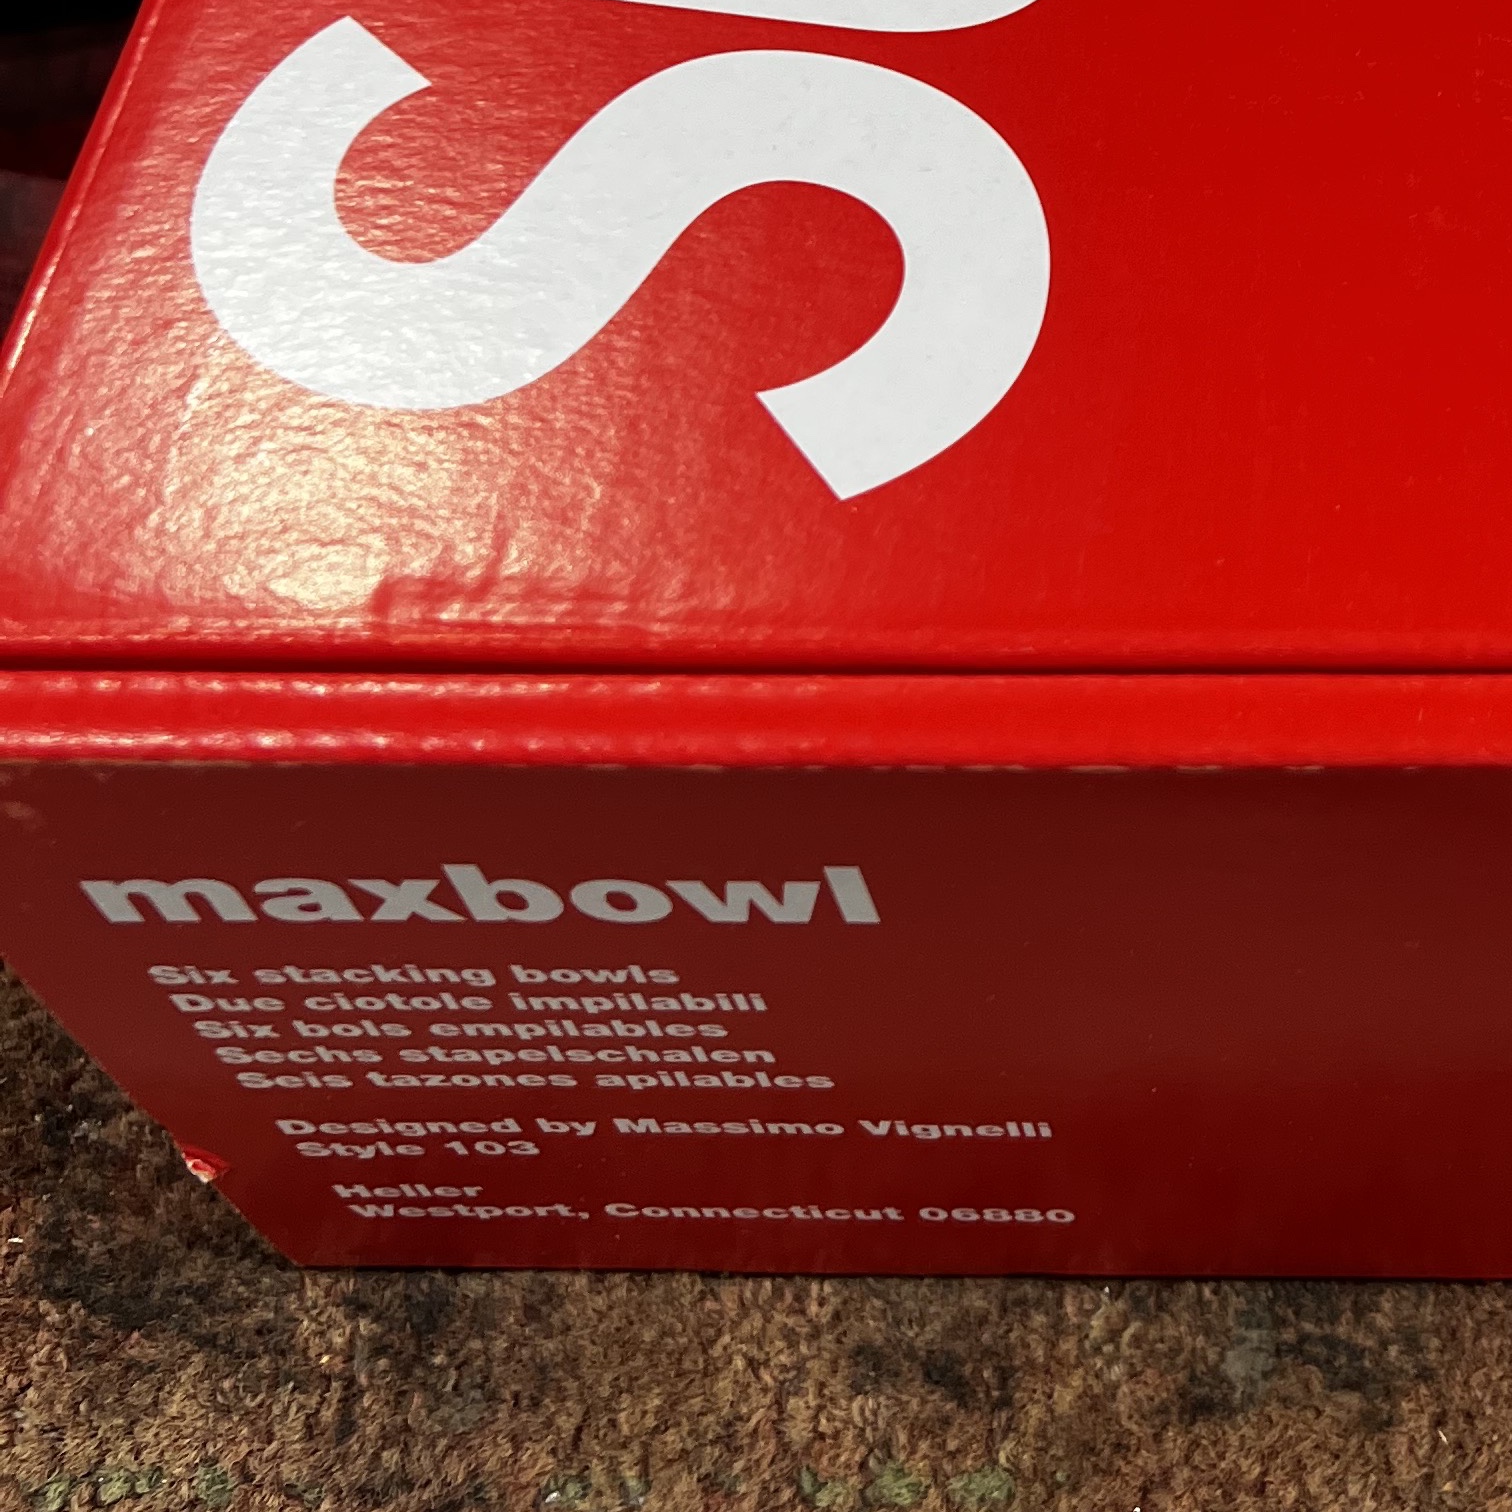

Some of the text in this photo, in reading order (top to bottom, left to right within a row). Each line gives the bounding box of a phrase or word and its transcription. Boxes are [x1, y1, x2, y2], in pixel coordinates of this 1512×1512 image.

[80, 863, 882, 925] maxbowl
[147, 964, 680, 987] Six stacking bowls
[168, 992, 768, 1014] Due ciotole impilabili
[193, 1019, 729, 1041] Six bols empilables
[215, 1045, 776, 1066] Sechs stapelschalen
[236, 1070, 835, 1090] Seis tazones apilables
[275, 1117, 1053, 1140] Designed by Massimo Vignelli
[296, 1140, 540, 1159] Style 103
[332, 1183, 484, 1198] Heller
[348, 1203, 1076, 1223] Westport, Connecticut 06880
